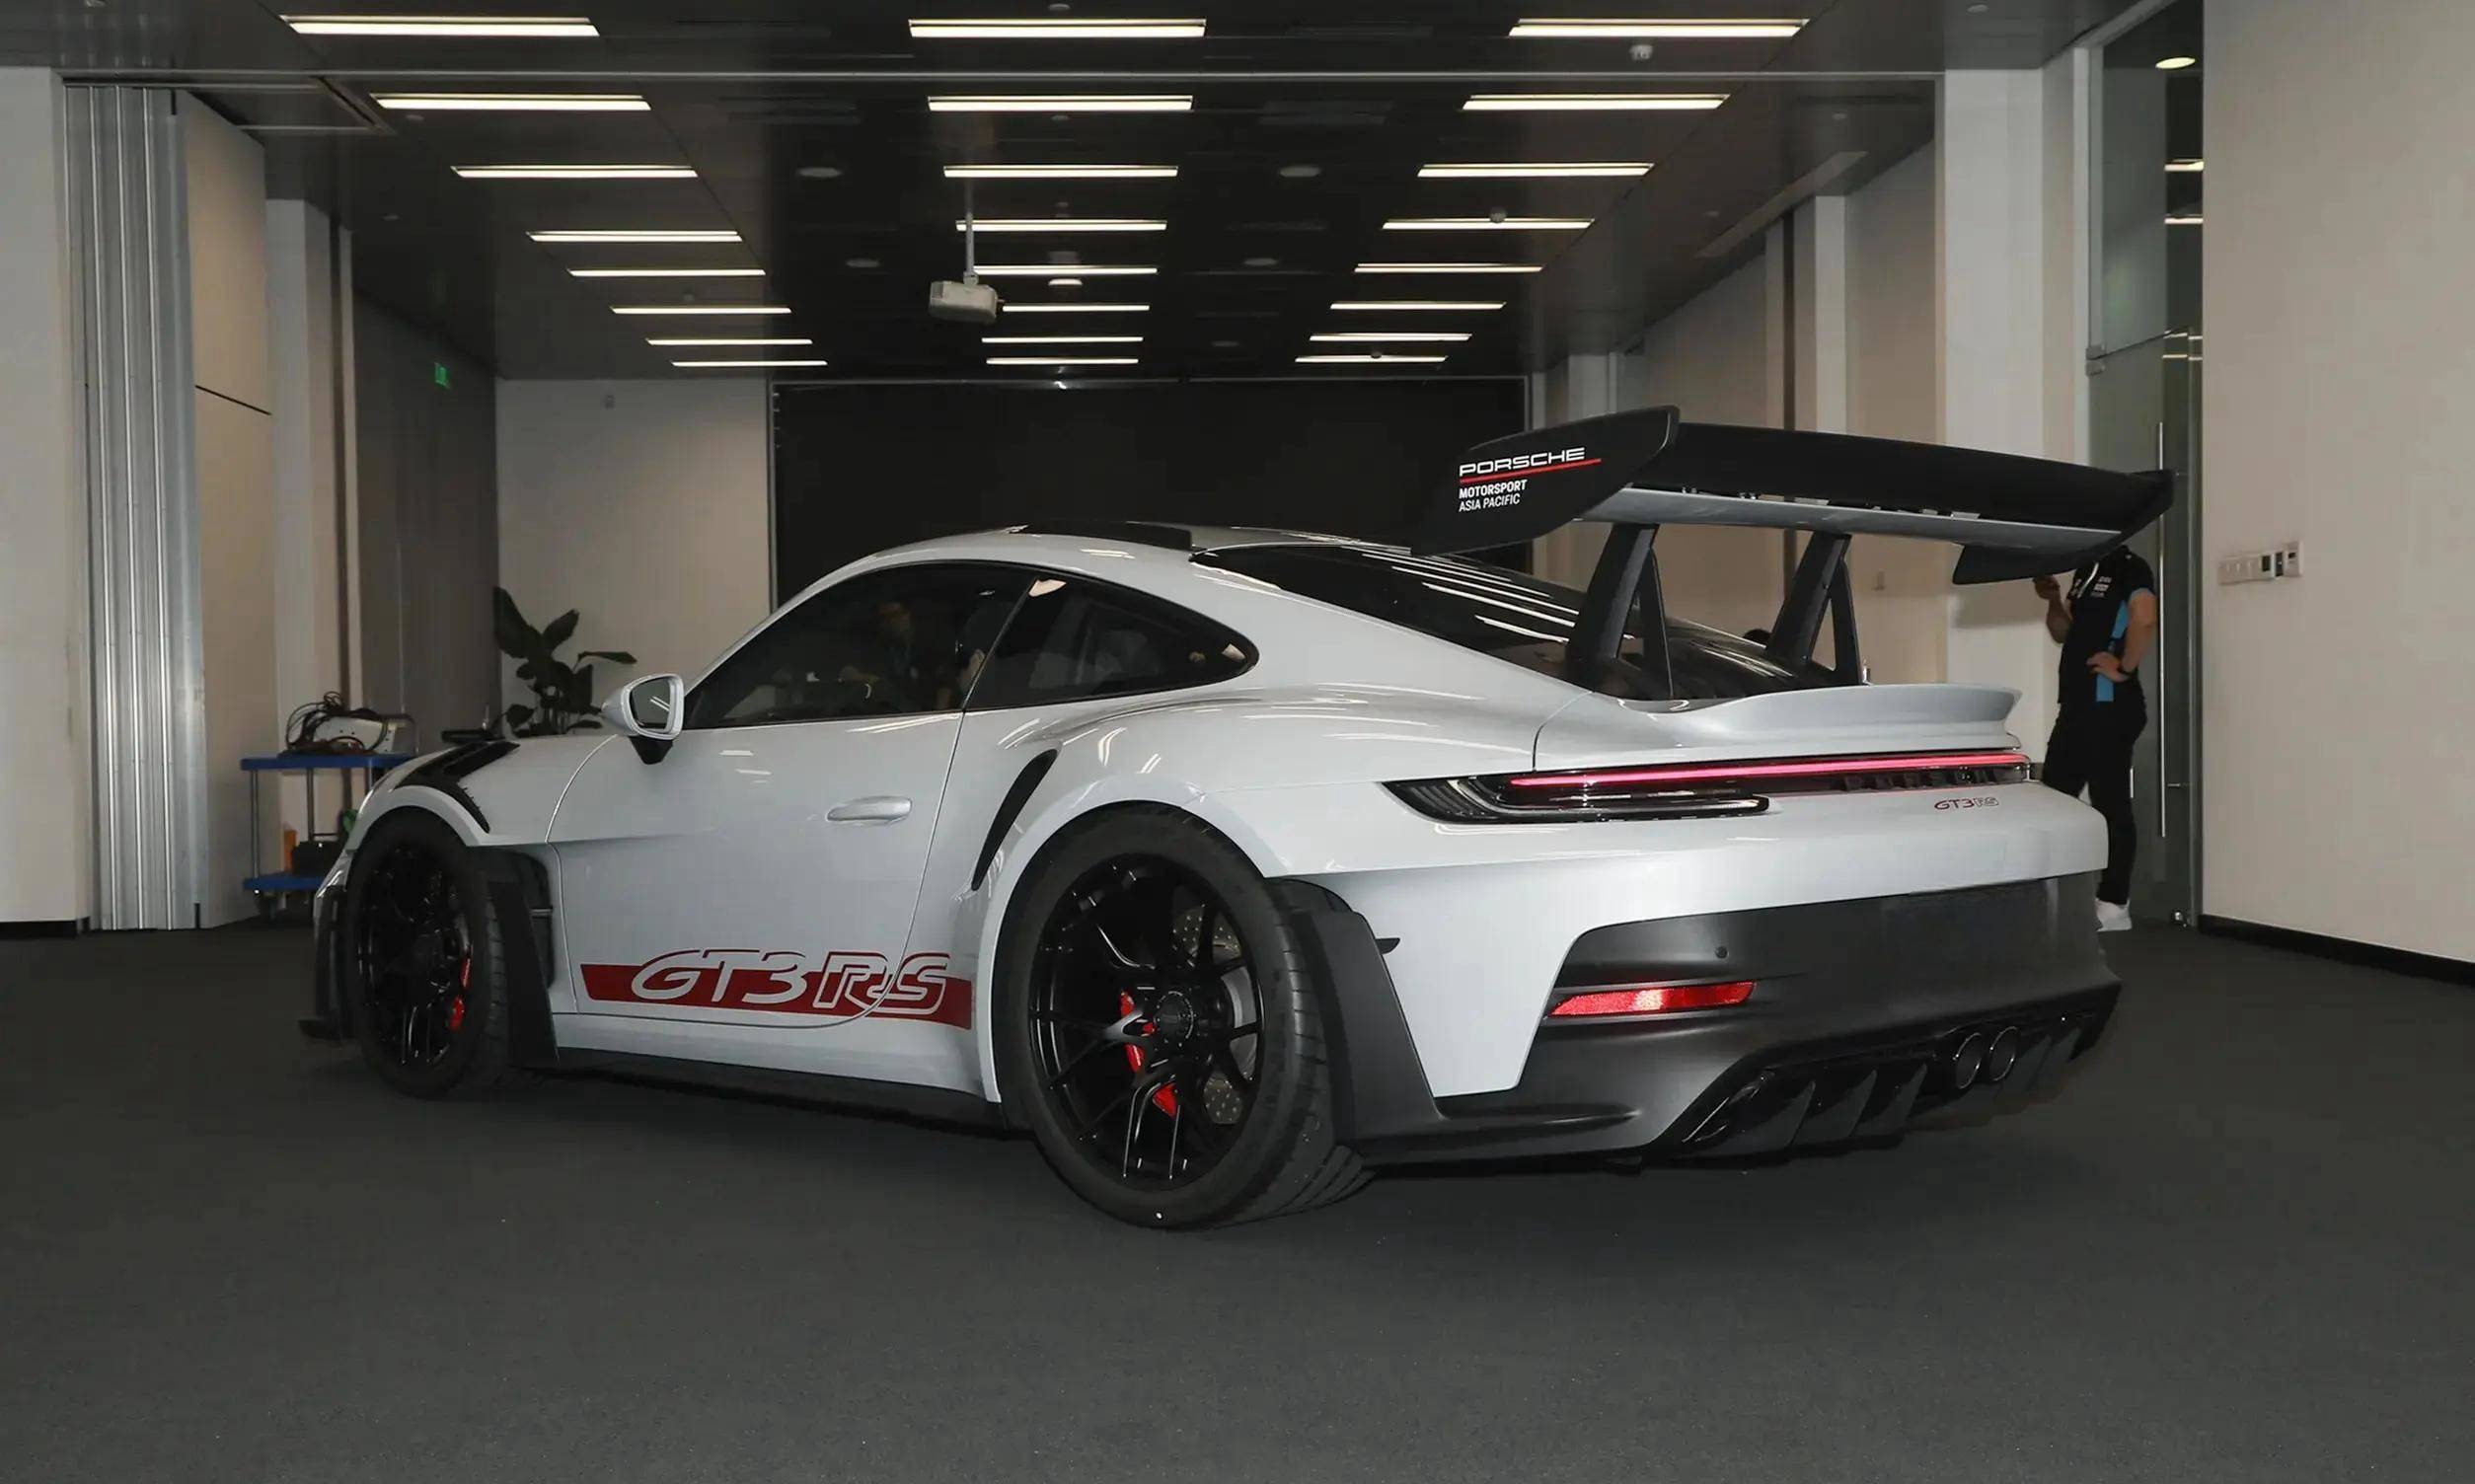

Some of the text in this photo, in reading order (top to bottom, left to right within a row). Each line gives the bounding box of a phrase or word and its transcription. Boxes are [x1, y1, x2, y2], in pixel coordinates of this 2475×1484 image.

[1460, 447, 1586, 477] PORSCHE
[1459, 480, 1528, 499] MOTORSPORT
[1459, 493, 1521, 512] ASIA PACIFIC
